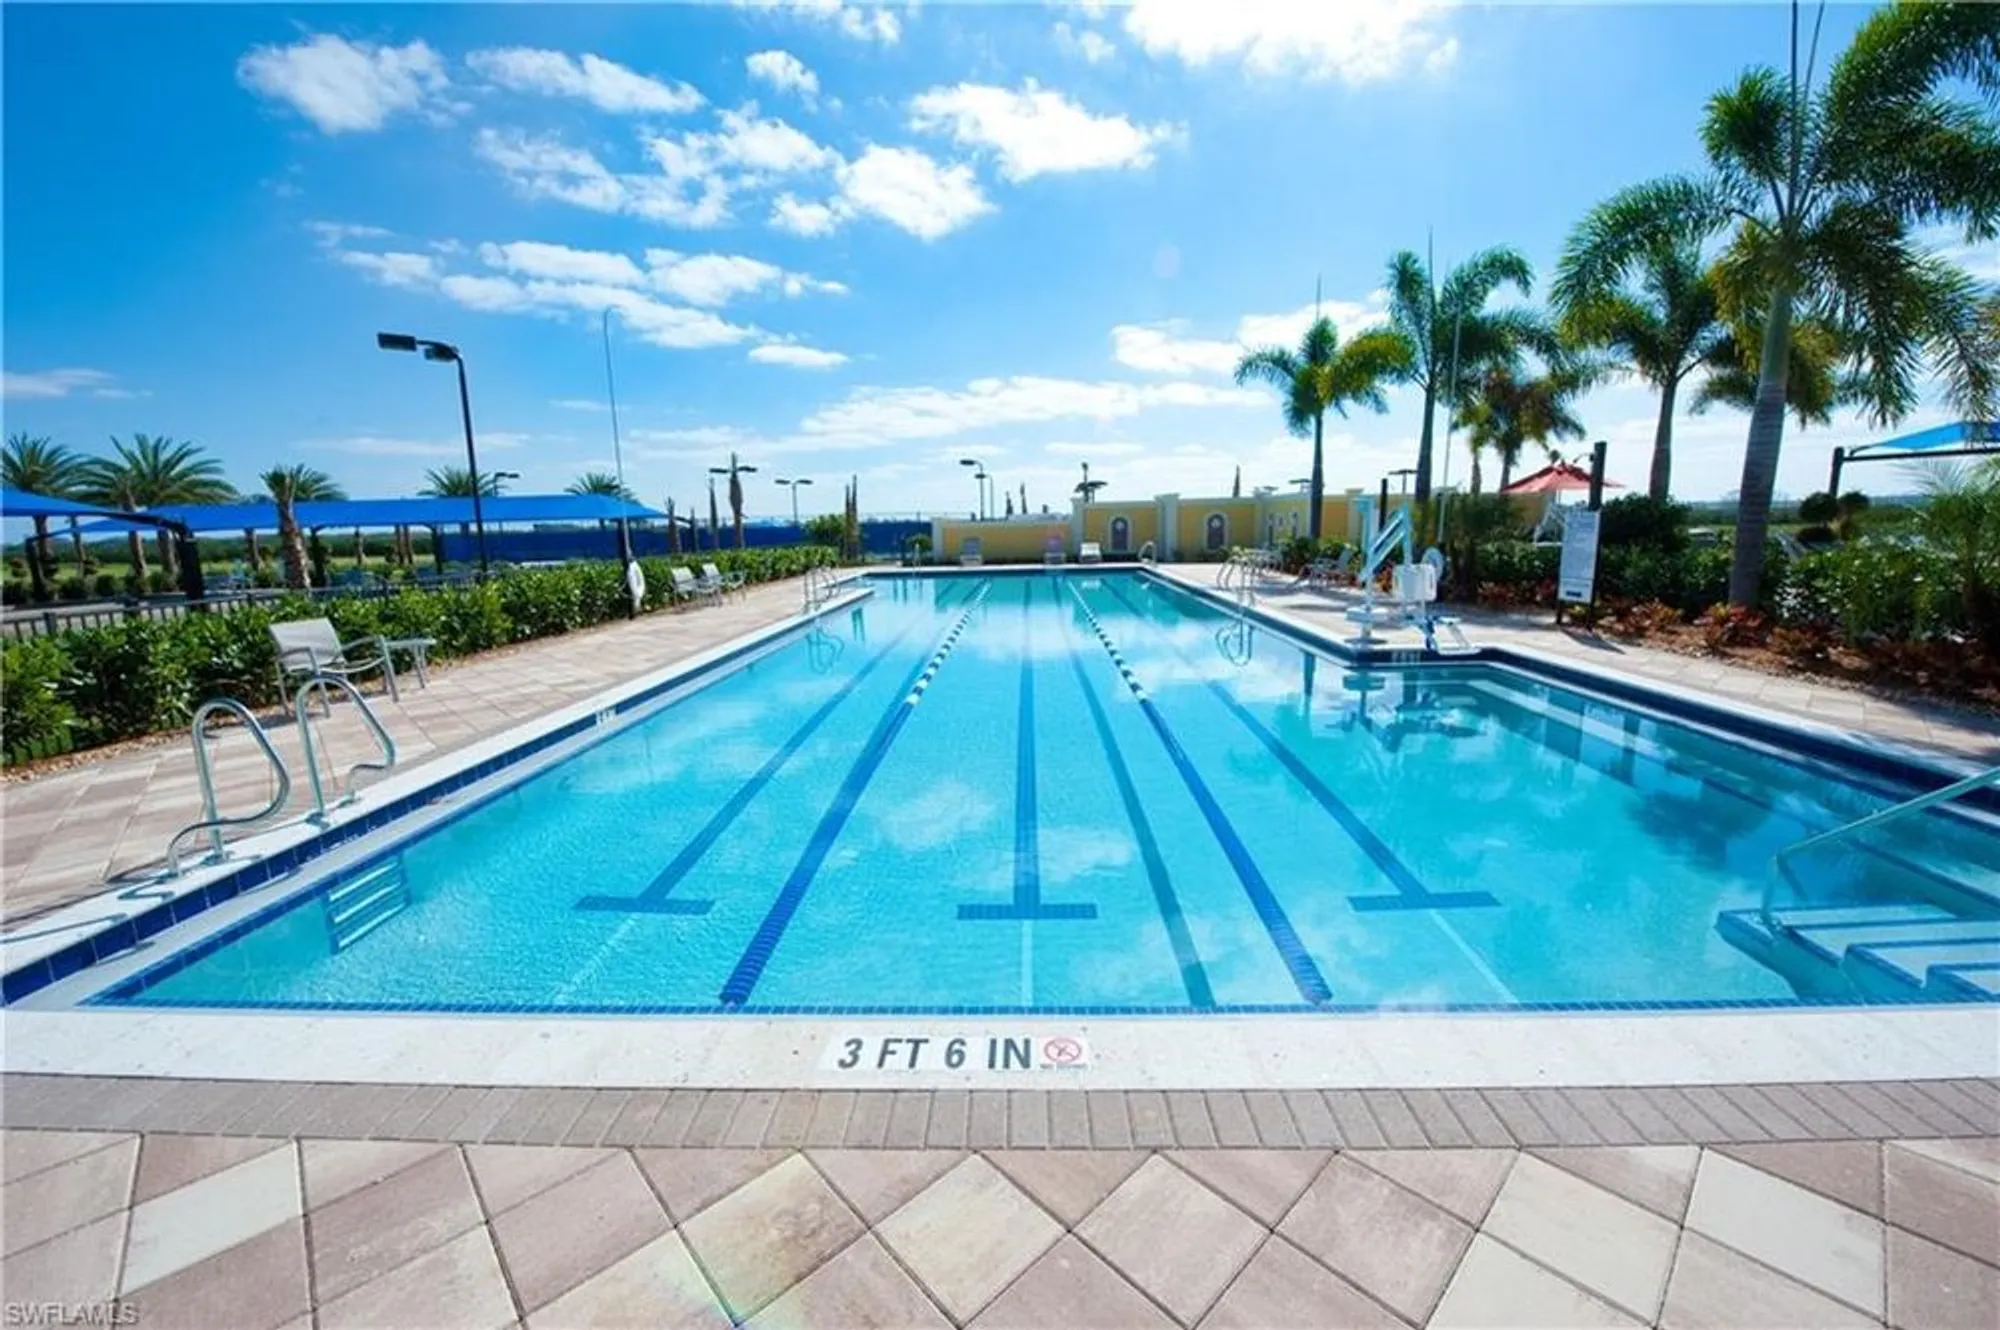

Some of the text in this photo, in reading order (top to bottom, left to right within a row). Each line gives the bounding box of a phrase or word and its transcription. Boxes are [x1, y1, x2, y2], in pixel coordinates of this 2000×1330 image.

[837, 1038, 1031, 1070] 3 FT 6 IN
